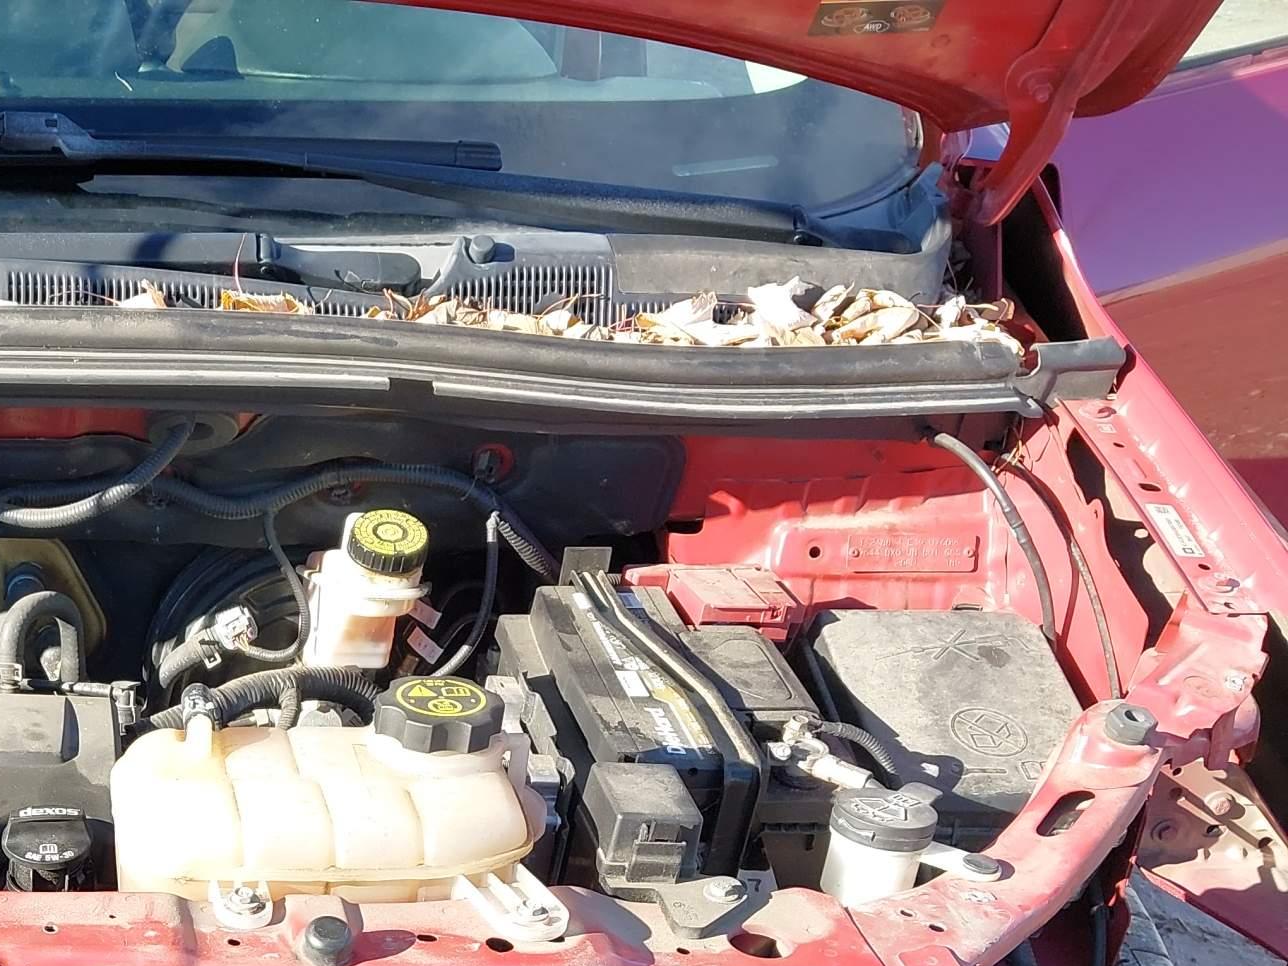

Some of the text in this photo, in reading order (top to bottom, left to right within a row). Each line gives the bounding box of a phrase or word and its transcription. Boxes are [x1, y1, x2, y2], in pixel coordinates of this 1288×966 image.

[863, 23, 882, 32] AWD
[644, 708, 686, 754] DieHard
[19, 807, 81, 818] dexos
[25, 850, 74, 861] SAE 5W-30
